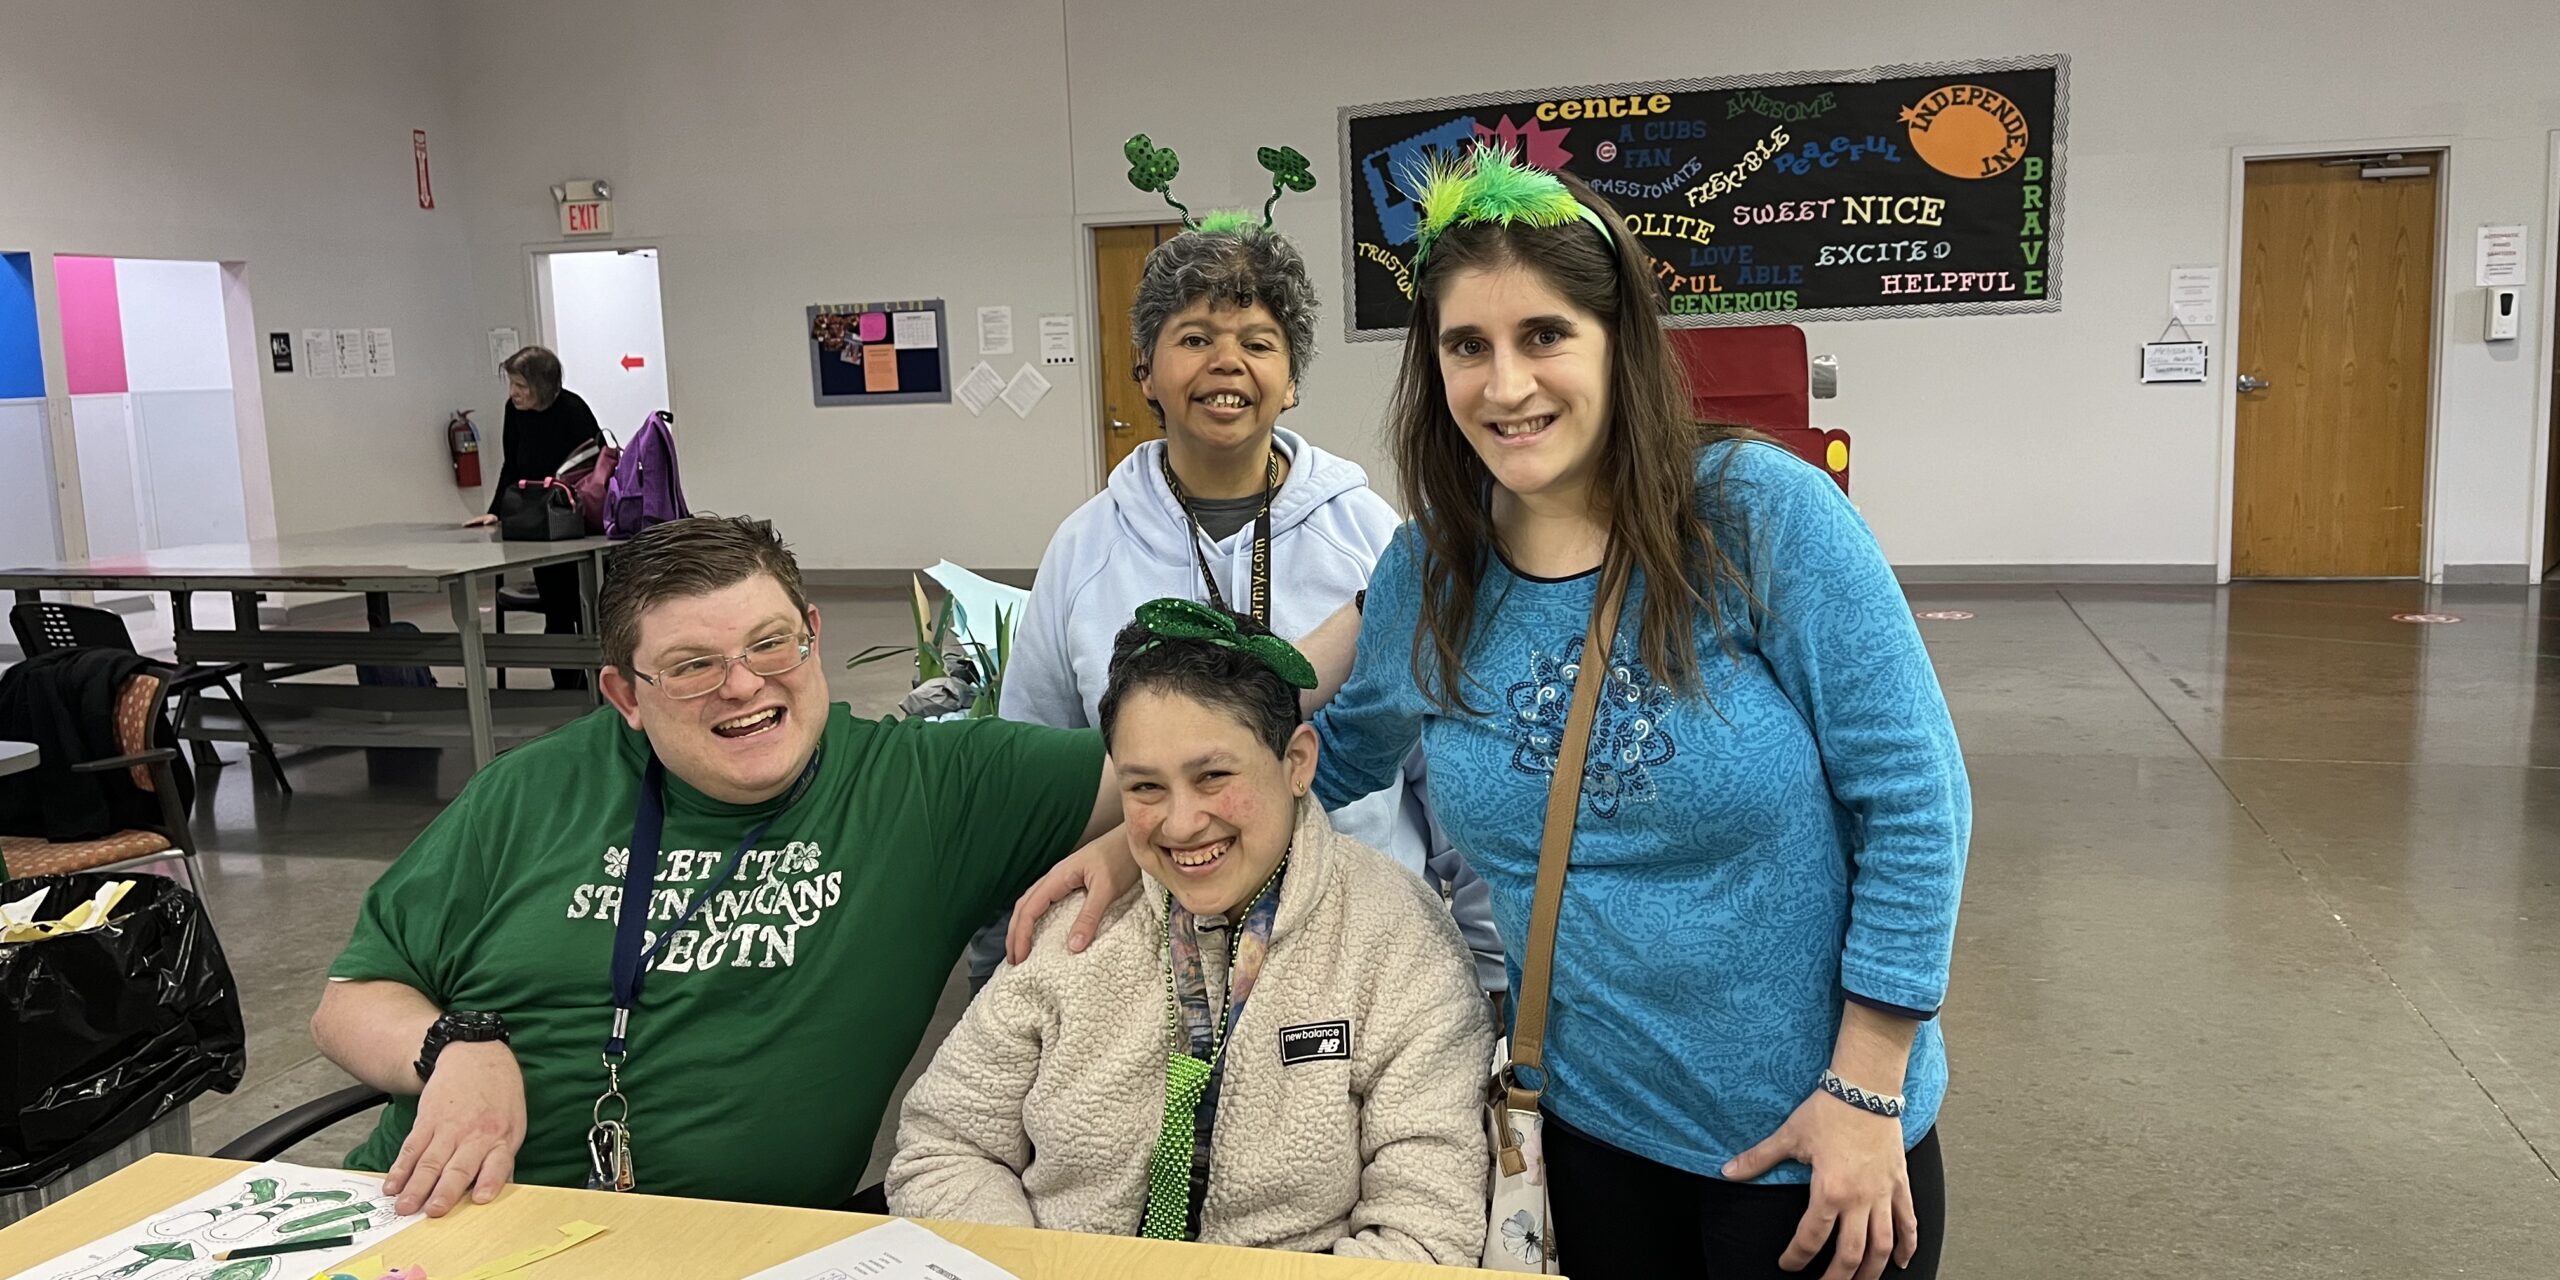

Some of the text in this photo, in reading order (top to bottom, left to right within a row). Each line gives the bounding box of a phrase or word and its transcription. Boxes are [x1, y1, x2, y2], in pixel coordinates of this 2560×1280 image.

[1725, 90, 1838, 123] AWESOME
[1617, 120, 1707, 143] A CUBS
[1910, 86, 2027, 177] INDEPENDENT
[1624, 147, 1672, 169] FAN
[1684, 124, 1791, 208] FLEXIBLE
[568, 203, 600, 231] EXIT
[1733, 195, 1946, 227] SWEET NICE
[1623, 212, 1716, 245] OLITE
[2019, 156, 2044, 295] BRAVE
[1689, 245, 1754, 268] LOVE
[1814, 240, 1952, 267] EXCITED
[1737, 264, 1804, 285] ABLE
[1880, 271, 2017, 295] HELPFUL
[1670, 289, 1799, 316] GENEROUS
[1252, 537, 1268, 626] army.com
[1284, 1028, 1340, 1043] new balance
